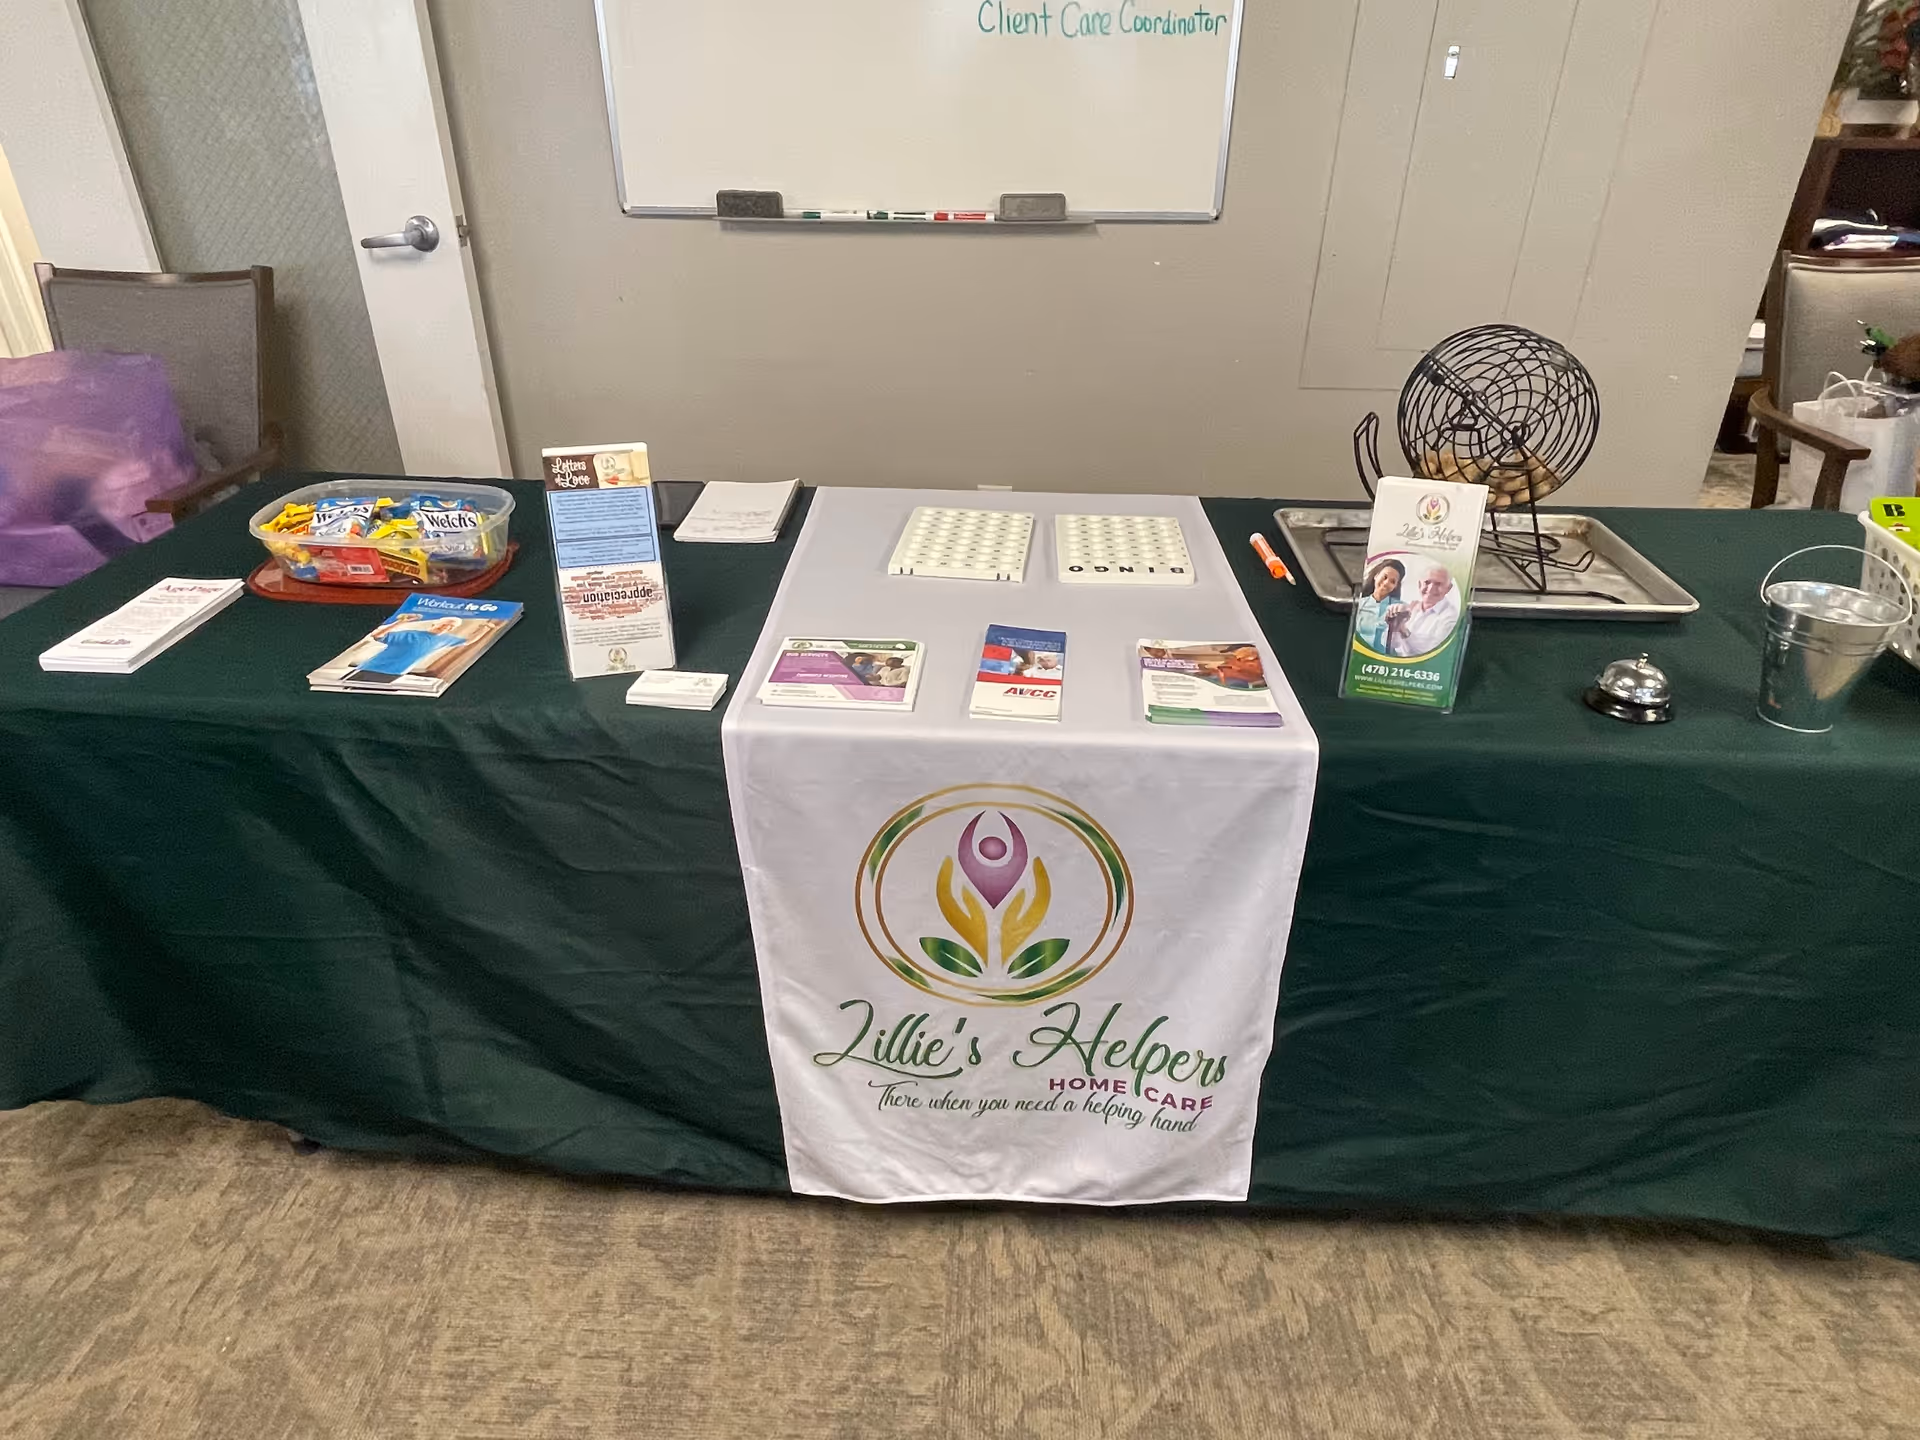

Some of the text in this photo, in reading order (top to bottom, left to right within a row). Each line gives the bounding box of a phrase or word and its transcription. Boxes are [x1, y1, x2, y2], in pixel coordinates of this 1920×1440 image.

[978, 0, 1228, 37] Client Care Coordinator
[551, 457, 587, 473] Letters
[561, 472, 591, 488] Love
[424, 513, 477, 528] Welch's
[1068, 565, 1185, 574] BINGO
[583, 587, 653, 603] appreciation
[418, 598, 464, 609] Workout
[465, 603, 478, 611] to
[480, 603, 498, 611] Go
[1361, 664, 1440, 681] (478) 216-6336
[1004, 687, 1057, 698] AVCC
[813, 999, 1226, 1097] Lillie's Helpers
[1049, 1078, 1213, 1112] HOME CARE
[868, 1080, 1204, 1132] There when you need a helping hand
